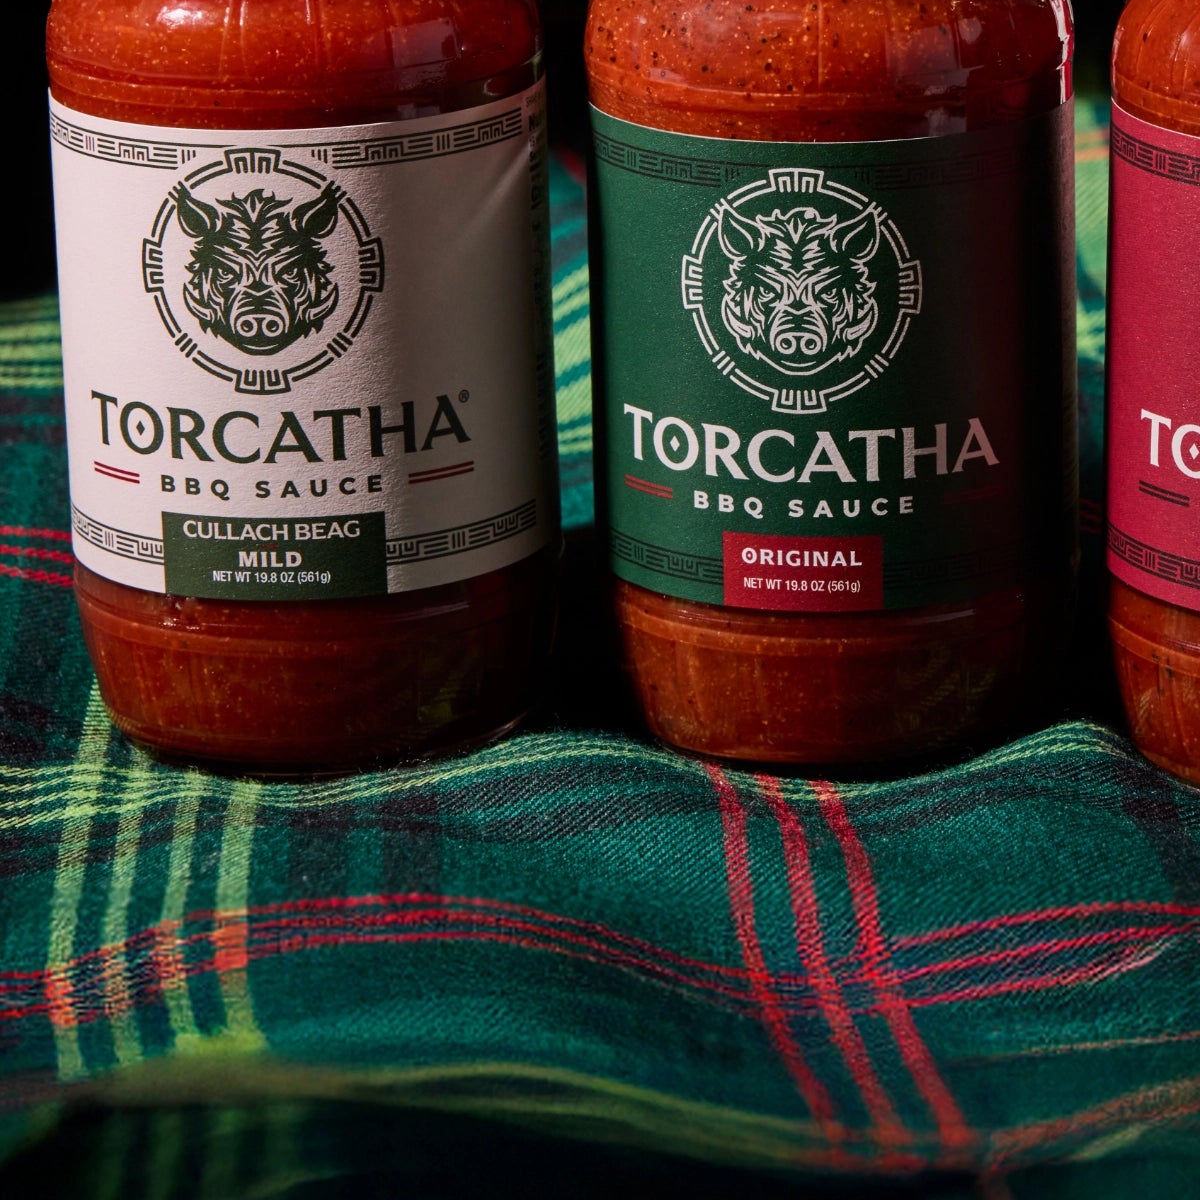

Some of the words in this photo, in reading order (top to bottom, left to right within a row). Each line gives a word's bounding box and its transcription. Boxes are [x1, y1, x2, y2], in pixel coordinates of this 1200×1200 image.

[623, 402, 1000, 484] TORCATHA
[161, 474, 230, 500] BBQ
[255, 474, 382, 499] SAUCE
[693, 490, 764, 520] BBQ
[788, 495, 914, 518] SAUCE
[182, 519, 289, 542] CULLACH
[294, 519, 361, 541] BEAG
[238, 551, 302, 568] MILD
[741, 546, 863, 568] ORIGINAL
[212, 570, 232, 582] NET
[235, 570, 251, 583] WT
[254, 571, 278, 583] 19.8
[280, 571, 296, 583] OZ
[297, 570, 331, 585] (561g)
[743, 577, 763, 590] NET
[766, 578, 782, 591] WT
[785, 579, 809, 592] 19.8
[810, 579, 825, 592] OZ
[828, 579, 861, 594] (561g)
